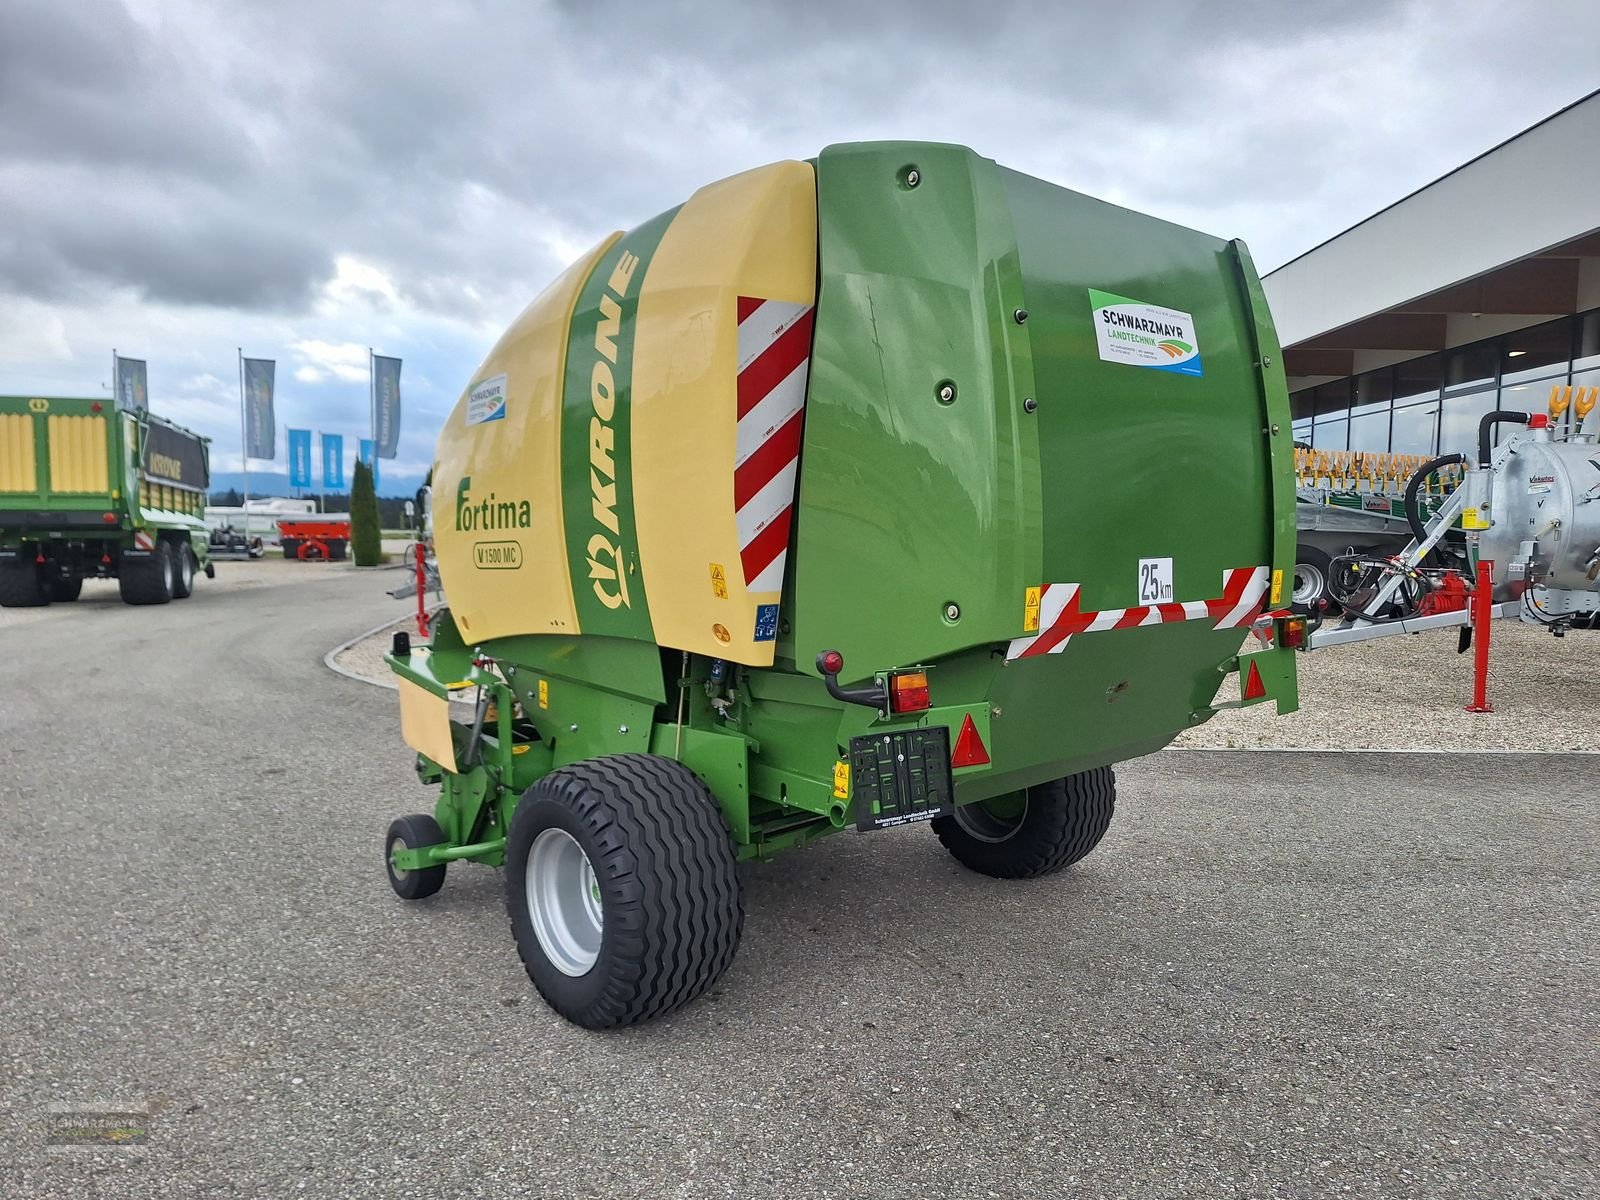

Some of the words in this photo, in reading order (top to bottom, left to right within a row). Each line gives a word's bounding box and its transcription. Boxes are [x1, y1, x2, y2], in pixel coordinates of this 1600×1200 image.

[1102, 309, 1184, 339] SCHWARZMAYR
[1107, 329, 1157, 347] LANDTECHNIK
[590, 250, 639, 536] KRONE
[150, 452, 181, 481] KRONE
[456, 476, 531, 531] Fortima
[477, 548, 484, 564] V
[485, 548, 502, 564] 1500
[503, 547, 516, 564] MC
[1141, 563, 1159, 601] 25
[1160, 580, 1172, 599] km
